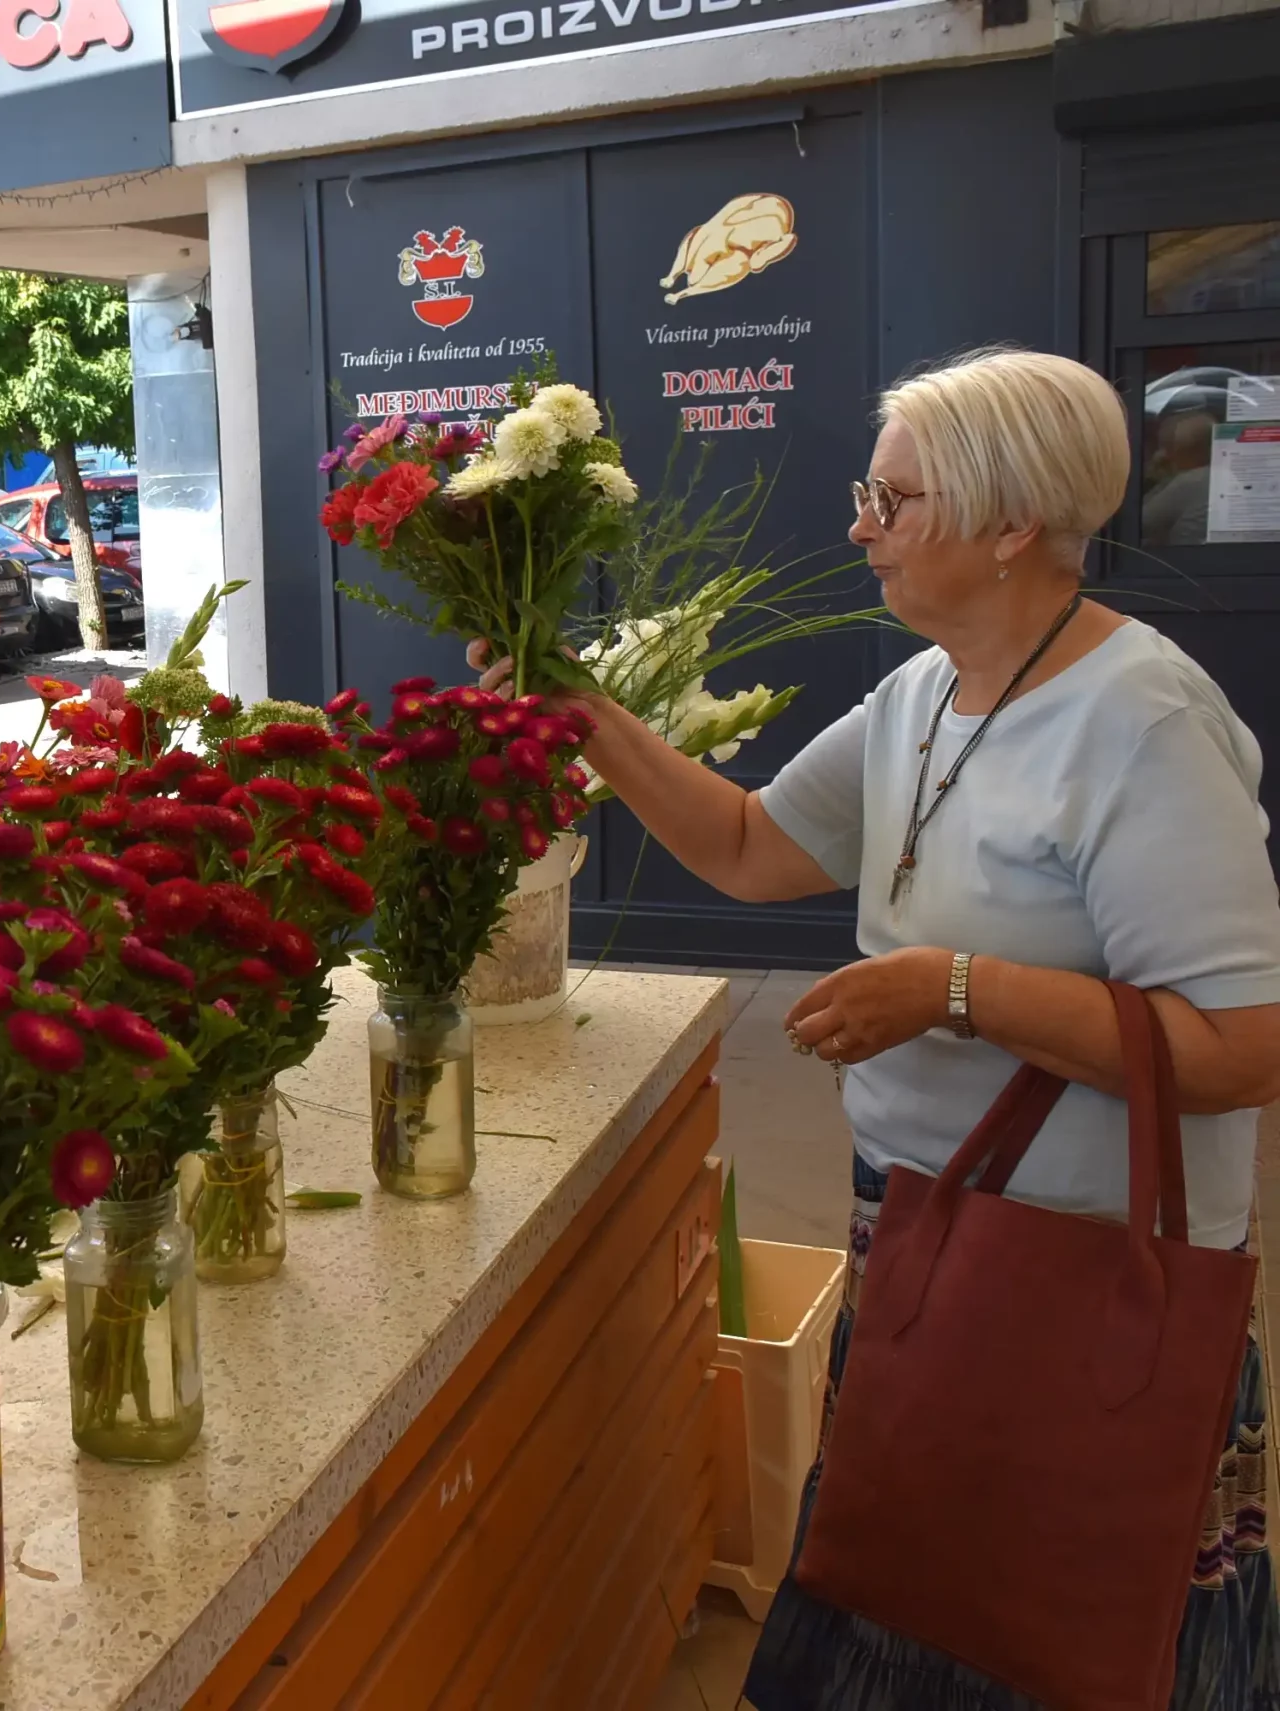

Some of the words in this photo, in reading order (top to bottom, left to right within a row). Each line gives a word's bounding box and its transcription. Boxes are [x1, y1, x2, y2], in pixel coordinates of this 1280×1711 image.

[412, 0, 783, 60] PROIZVO
[645, 324, 708, 344] Vlastita
[707, 315, 812, 348] proizvodnja
[340, 348, 403, 372] Tradicija
[408, 347, 413, 363] i
[418, 341, 480, 362] kvaliteta
[485, 337, 507, 357] od
[662, 358, 794, 397] DOMAĆI
[681, 396, 776, 432] PILIĆI
